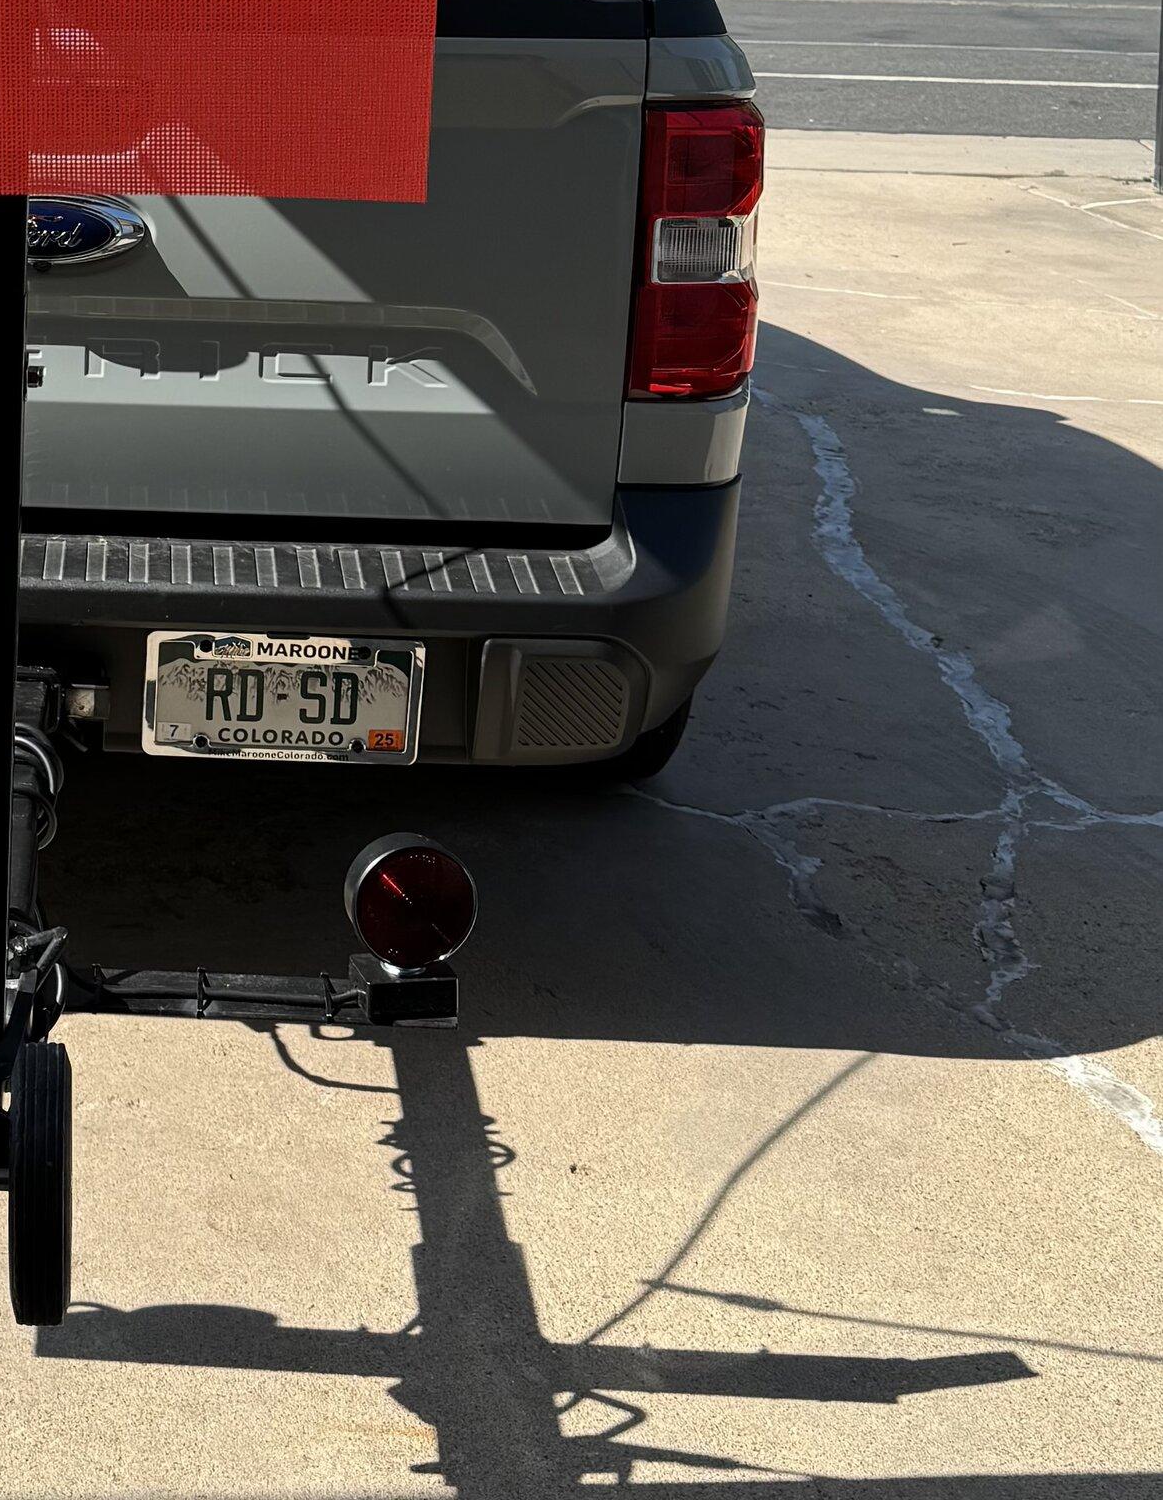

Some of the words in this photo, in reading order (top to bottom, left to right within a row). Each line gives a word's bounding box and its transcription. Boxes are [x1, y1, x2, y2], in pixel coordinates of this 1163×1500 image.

[257, 642, 359, 661] MAROONE
[169, 724, 179, 738] 7
[218, 727, 344, 746] COLORADO
[374, 732, 395, 746] 25
